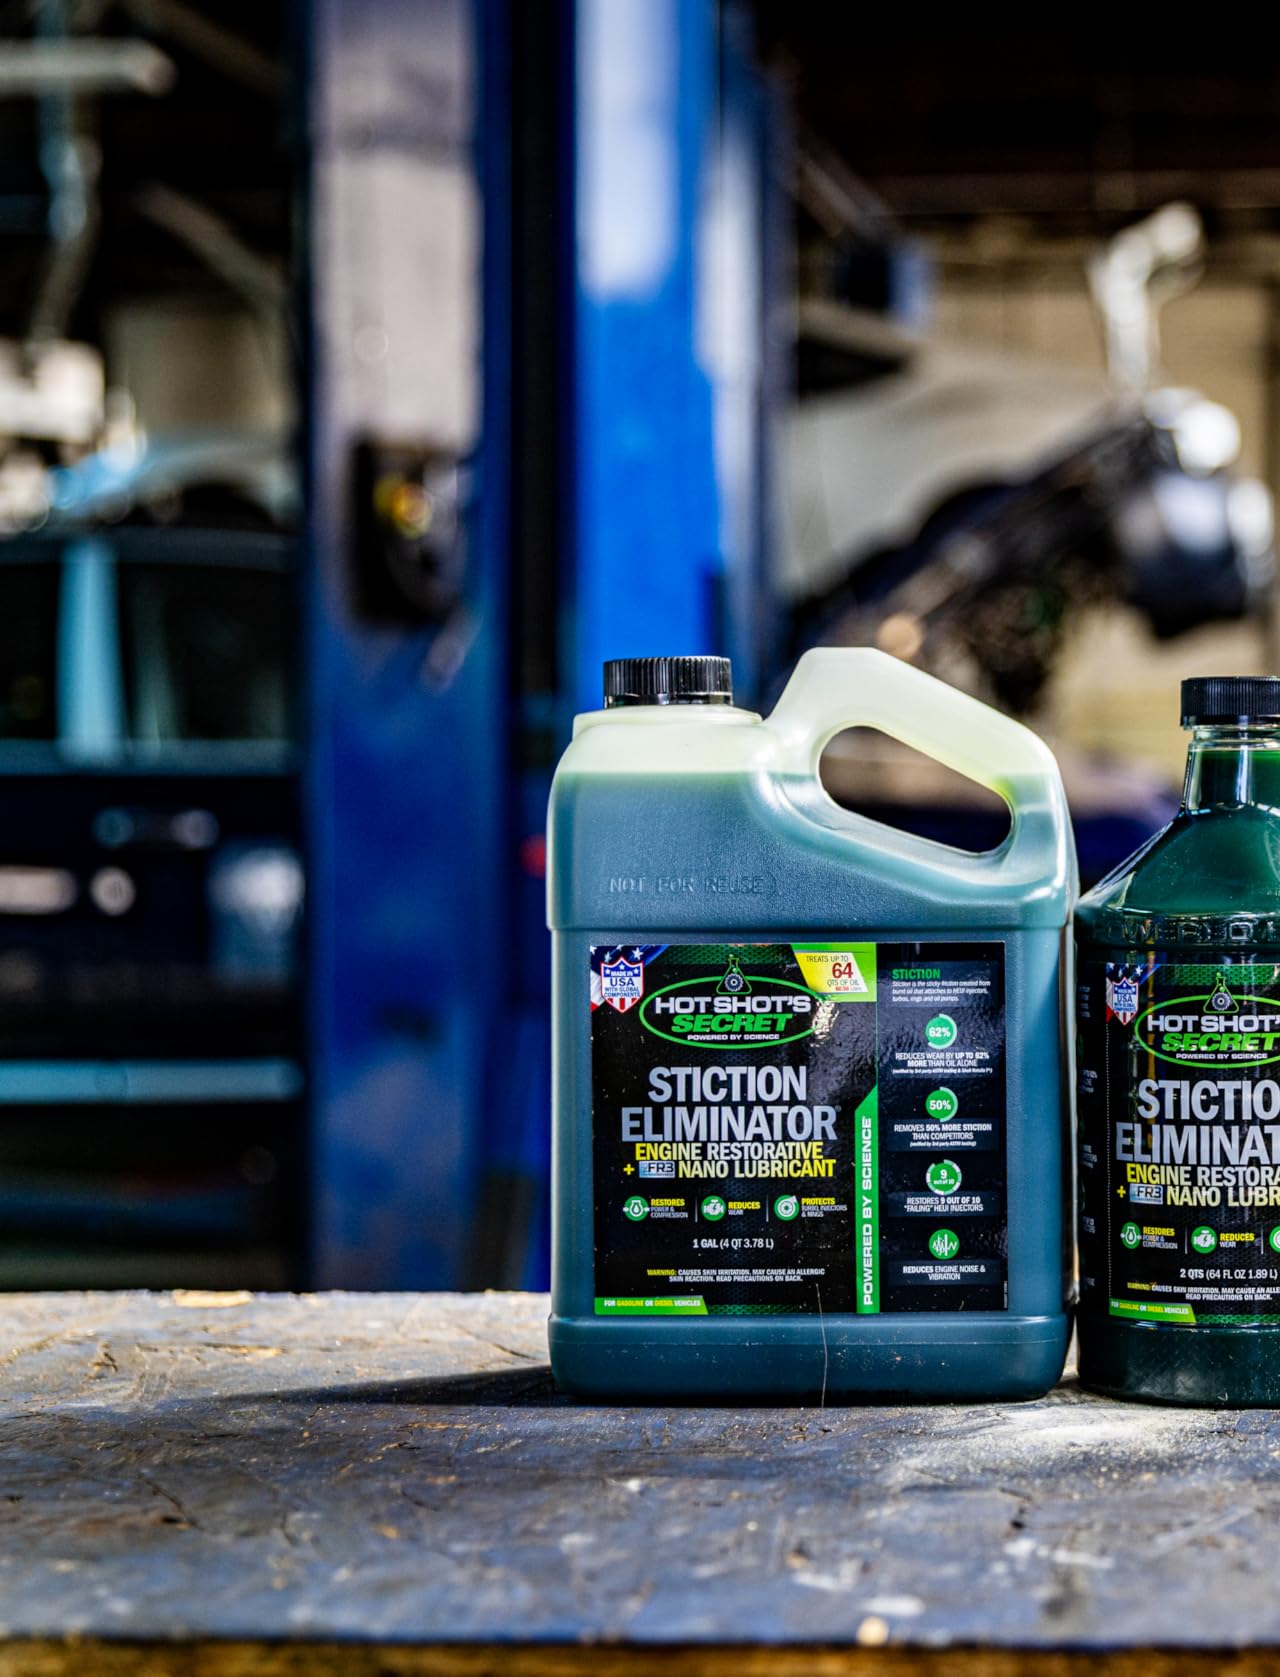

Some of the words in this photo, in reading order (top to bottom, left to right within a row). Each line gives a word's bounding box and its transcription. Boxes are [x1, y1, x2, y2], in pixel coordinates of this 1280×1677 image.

[610, 877, 645, 892] NOT
[658, 876, 695, 892] FOR
[704, 876, 764, 893] REUSE
[832, 962, 854, 979] 64
[892, 969, 940, 980] STICTION
[610, 977, 635, 986] USA
[827, 979, 839, 987] QTS
[1117, 993, 1133, 1003] USA
[655, 997, 711, 1014] HOT
[713, 996, 811, 1013] SHOT'S
[671, 1013, 793, 1033] SECRET
[1148, 1015, 1199, 1032] HOT
[744, 1033, 780, 1041] SCIENCE
[928, 1026, 951, 1038] 62%
[1161, 1032, 1280, 1051] SECRET
[895, 1052, 926, 1060] REDUCES
[926, 1052, 945, 1060] WEAR
[945, 1052, 954, 1060] BY
[955, 1052, 965, 1060] UP
[966, 1052, 974, 1060] TO
[975, 1051, 990, 1060] 62%
[1231, 1052, 1268, 1060] SCIENCE
[957, 1059, 977, 1067] ALONE
[648, 1066, 807, 1103] STICTION
[930, 1099, 952, 1110] 50%
[894, 1124, 925, 1132] REMOVES
[963, 1123, 992, 1131] STICTION
[912, 1132, 930, 1140] THAN
[930, 1132, 974, 1140] COMPETITORS
[635, 1142, 702, 1161] ENGINE
[707, 1141, 824, 1160] RESTORATIVE
[862, 1116, 872, 1190] SCIENCE
[678, 1160, 730, 1178] NANO
[734, 1159, 836, 1178] LUBRICANT
[940, 1169, 948, 1179] 9
[1127, 1163, 1192, 1186] ENGINE
[907, 1197, 940, 1205] RESTORES
[973, 1196, 981, 1204] 10
[1167, 1184, 1221, 1207] NANO
[651, 1198, 686, 1207] RESTORES
[728, 1201, 761, 1210] REDUCES
[801, 1197, 836, 1206] PROTECTS
[862, 1195, 872, 1219] BY
[951, 1204, 984, 1212] INJECTORS
[1143, 1226, 1175, 1237] RESTORES
[1219, 1232, 1255, 1242] REDUCES
[693, 1239, 699, 1249] 1
[700, 1239, 719, 1249] GAL
[720, 1238, 730, 1250] (4
[731, 1239, 743, 1250] QT
[744, 1239, 764, 1249] 3.78
[766, 1238, 775, 1250] L)
[862, 1223, 873, 1306] POWERED
[903, 1265, 934, 1274] REDUCES
[935, 1265, 958, 1273] ENGINE
[1180, 1269, 1187, 1279] 2
[1187, 1269, 1204, 1280] QTS
[1206, 1269, 1221, 1281] (64
[1223, 1270, 1233, 1279] FL
[1234, 1269, 1246, 1279] OZ
[1248, 1269, 1268, 1279] 1.89
[1270, 1268, 1278, 1280] L)
